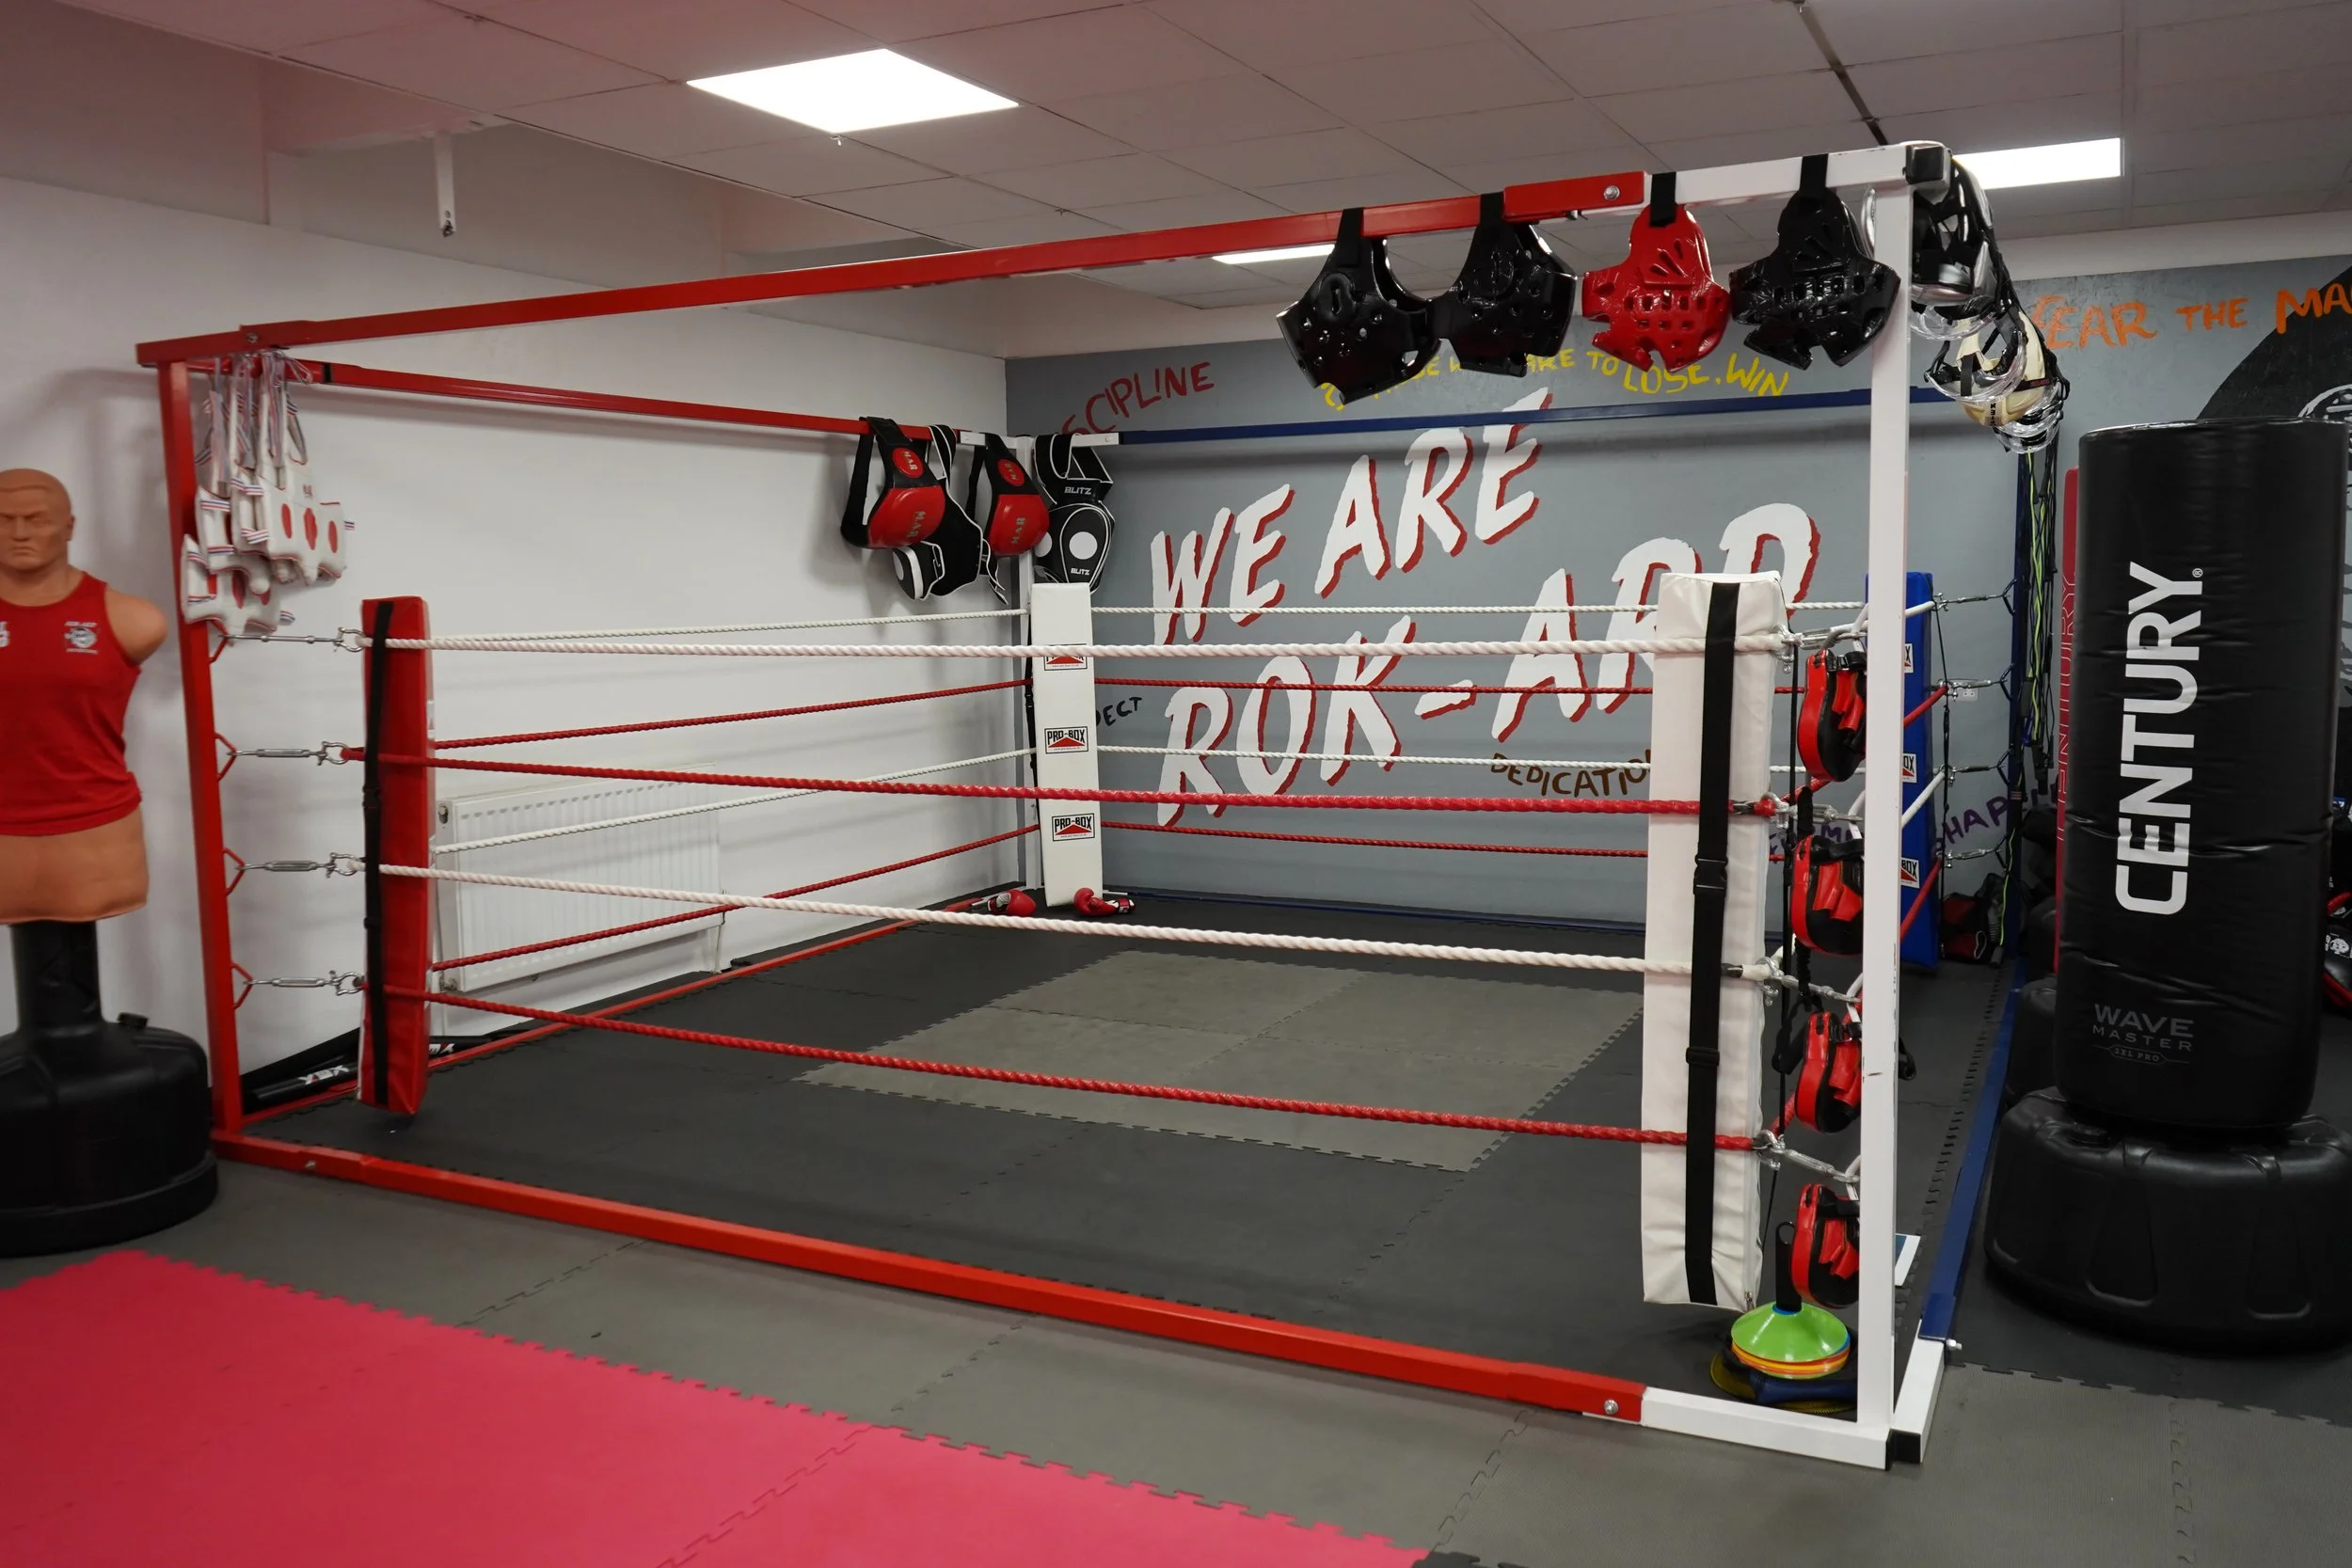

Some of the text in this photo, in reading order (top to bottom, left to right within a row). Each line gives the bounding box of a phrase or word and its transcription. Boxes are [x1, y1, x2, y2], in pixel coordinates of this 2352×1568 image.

[2175, 297, 2249, 333] THE
[2275, 282, 2352, 335] MA
[1586, 350, 1620, 376] TO
[1725, 353, 1789, 397] WIN
[1062, 361, 1216, 435] SCIPLINE
[1064, 486, 1092, 496] BLITZ
[1151, 387, 1554, 648] WE ARE
[1070, 567, 1090, 576] BLITZ
[1046, 729, 1086, 746] PRO-BOX
[1490, 749, 1651, 798] DEDICATIO
[1054, 816, 1092, 833] PRO-BOX
[2094, 1003, 2195, 1038] WAVE
[2092, 1024, 2192, 1052] MASTER
[2137, 1053, 2159, 1062] PRO
